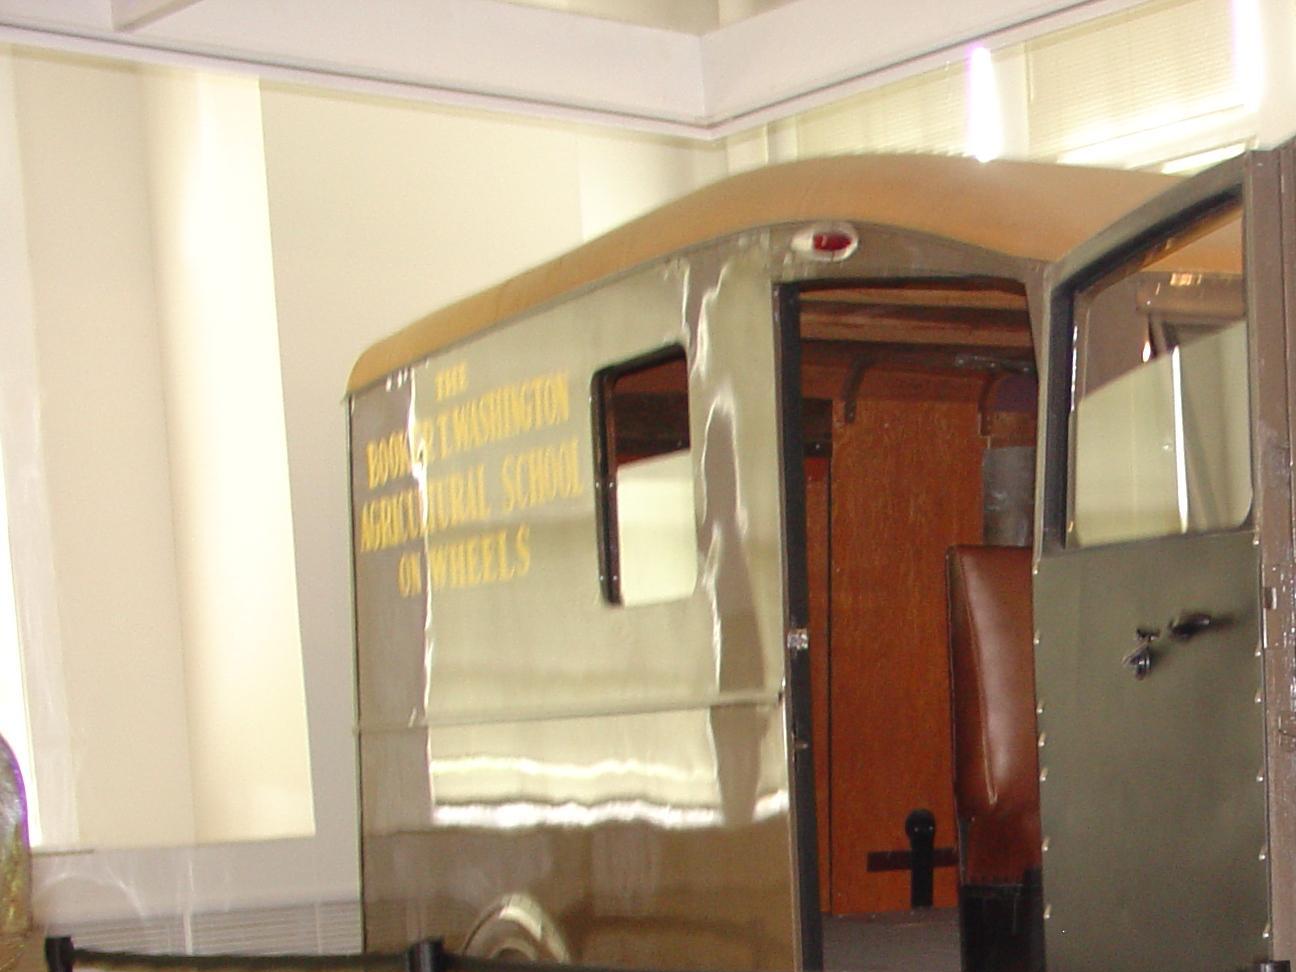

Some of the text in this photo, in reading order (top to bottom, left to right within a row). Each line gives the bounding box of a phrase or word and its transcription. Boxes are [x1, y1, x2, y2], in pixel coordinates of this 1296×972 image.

[367, 418, 434, 489] BOOKR
[453, 373, 568, 451] WASHINGTON
[502, 439, 582, 512] SCHOOL
[399, 523, 529, 598] ON WHEELS
